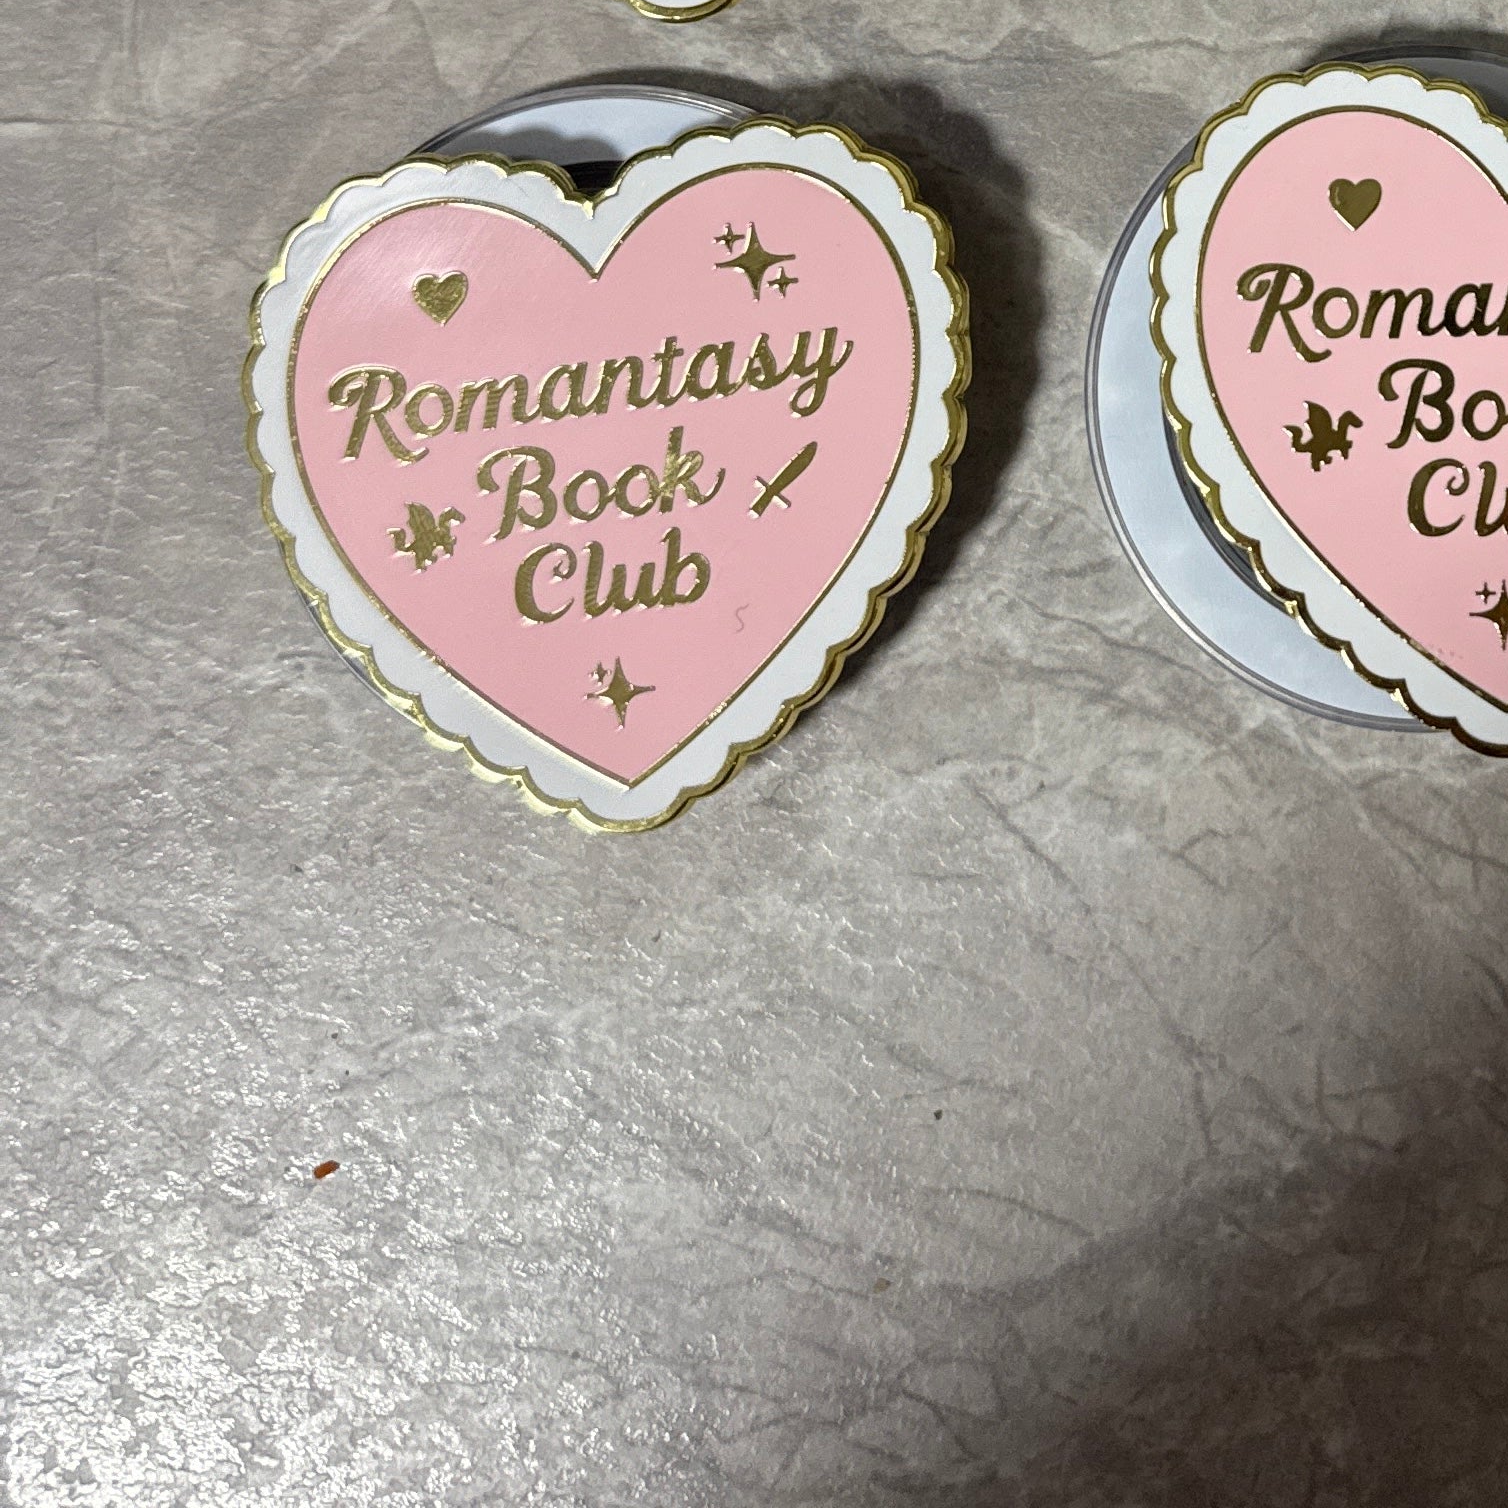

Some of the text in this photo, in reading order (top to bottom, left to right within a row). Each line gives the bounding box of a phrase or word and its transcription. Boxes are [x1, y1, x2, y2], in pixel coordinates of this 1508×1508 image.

[328, 326, 854, 465] Romantasy
[476, 426, 725, 545] Book
[514, 526, 711, 625] Club
